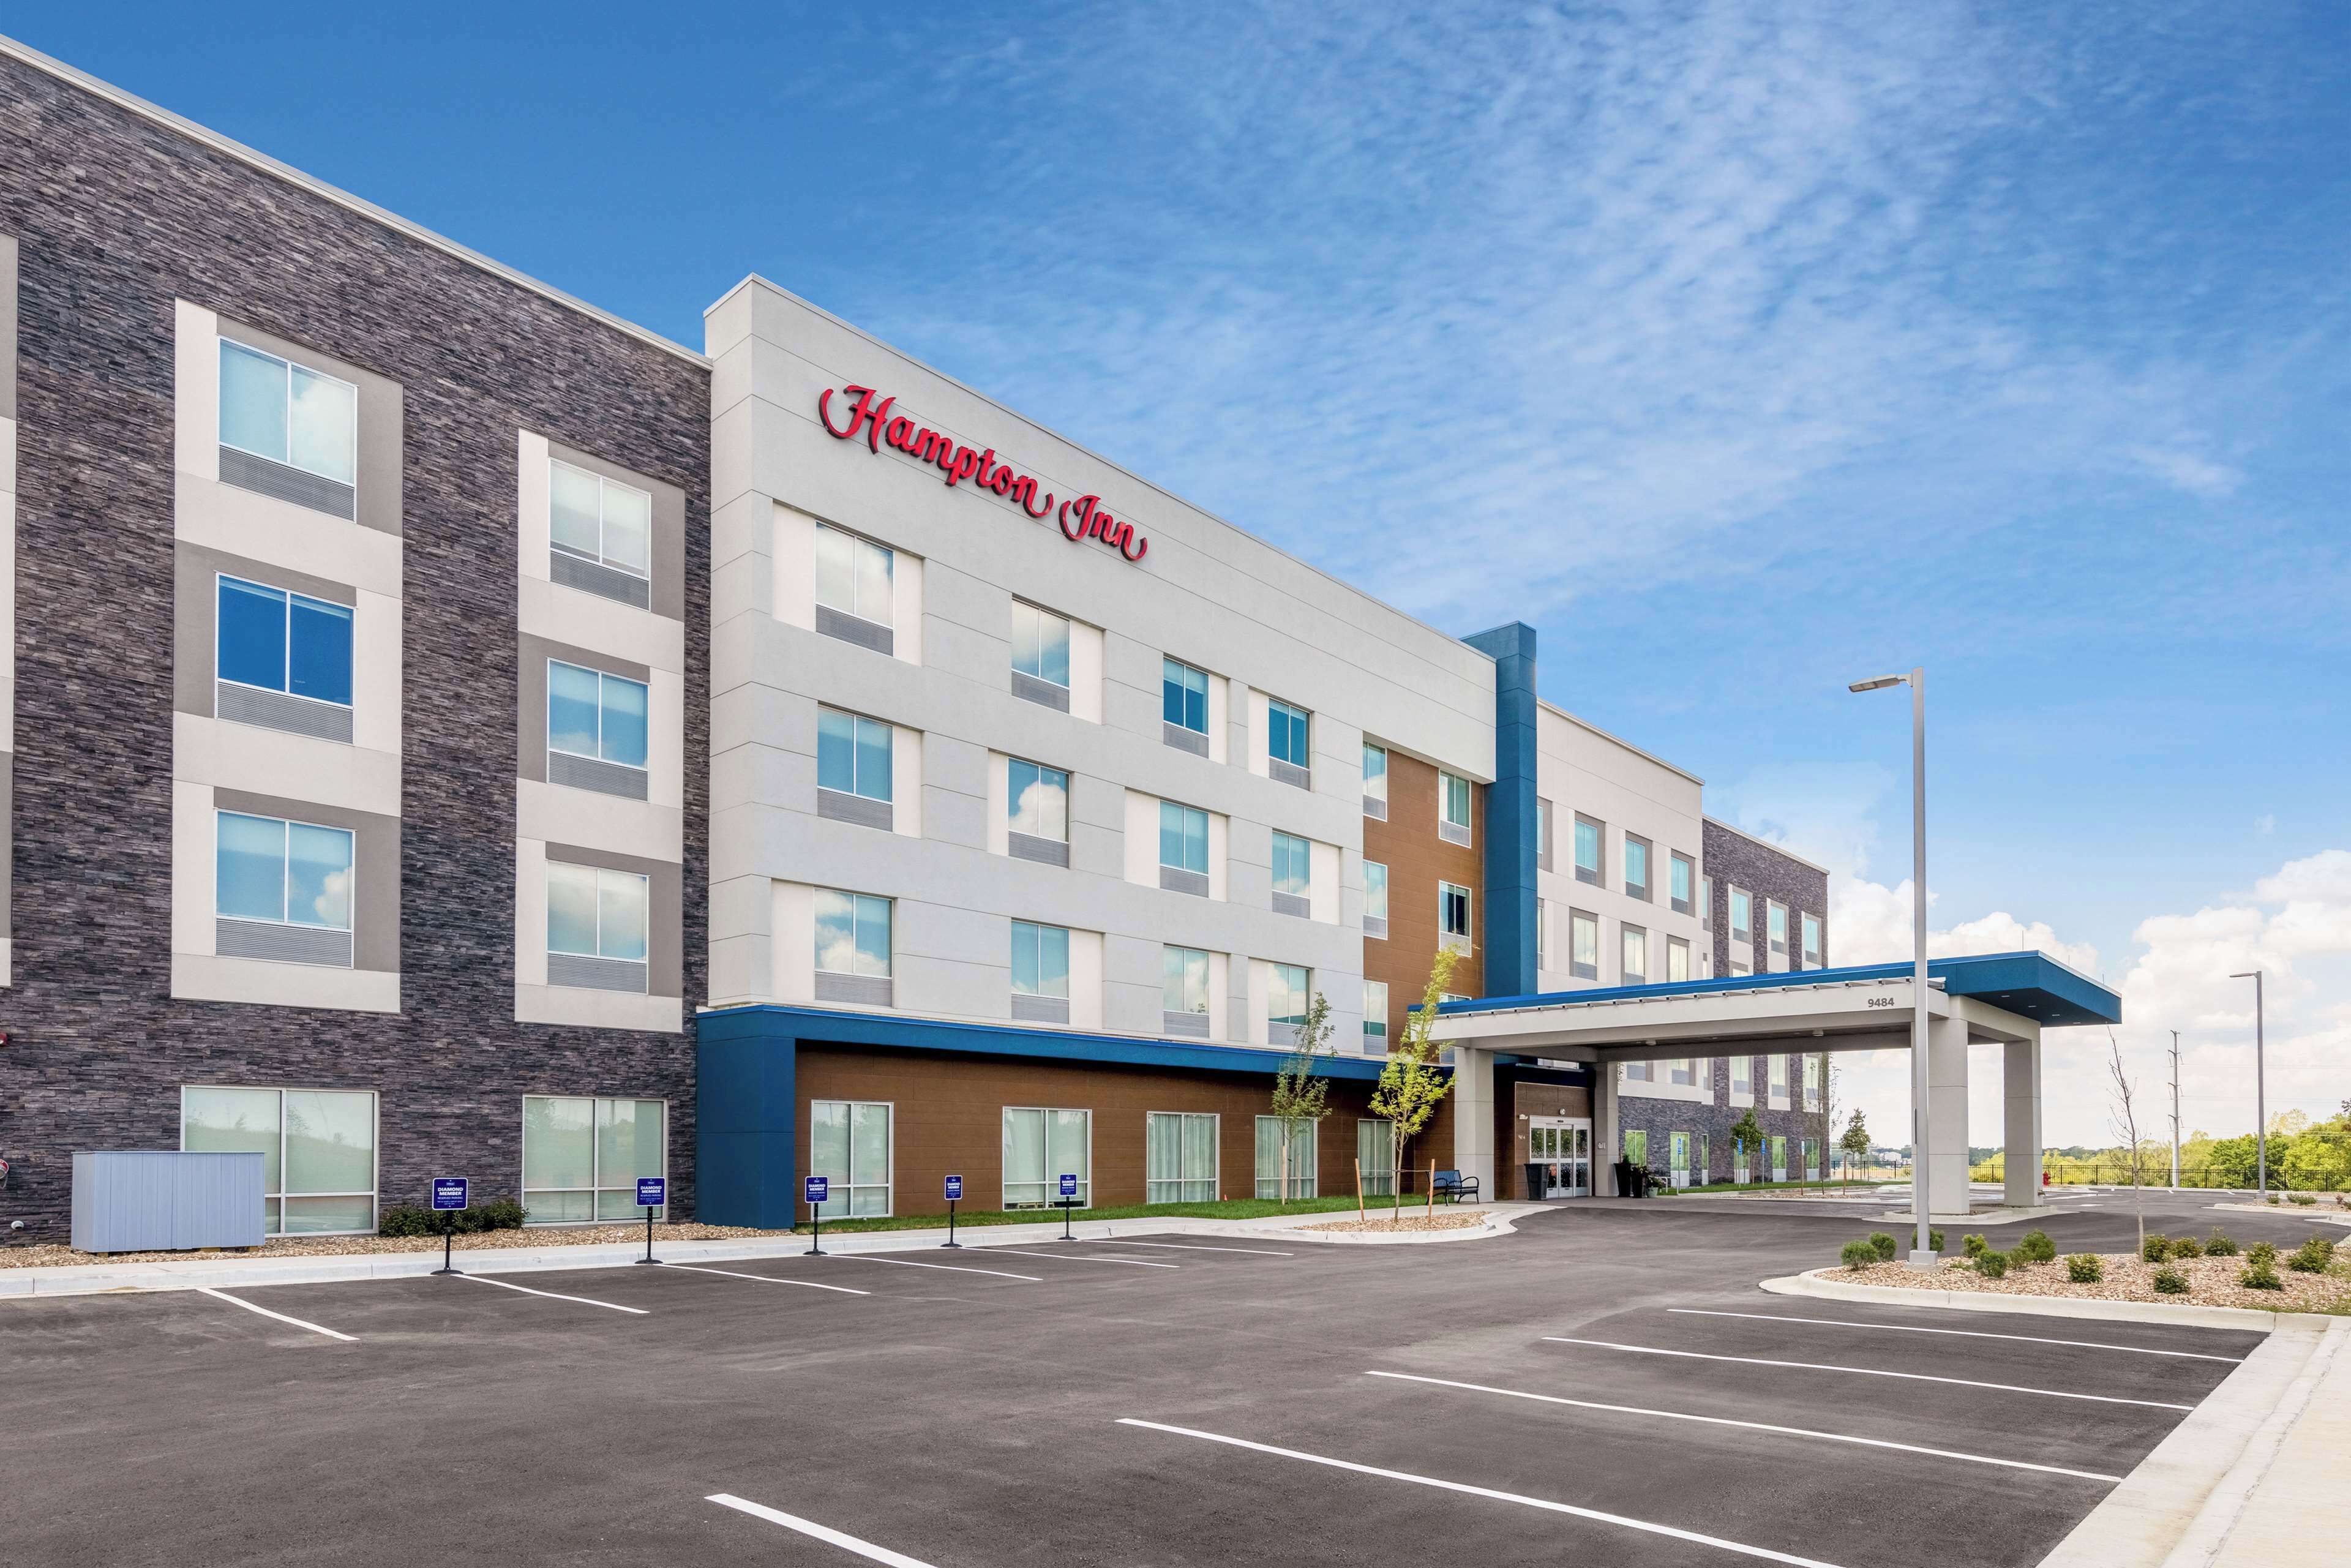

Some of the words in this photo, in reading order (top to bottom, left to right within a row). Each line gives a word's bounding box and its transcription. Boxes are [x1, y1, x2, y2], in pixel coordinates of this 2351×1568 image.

[819, 384, 1054, 518] Hampton
[1059, 495, 1148, 561] Inn
[1867, 997, 1895, 1007] 9484
